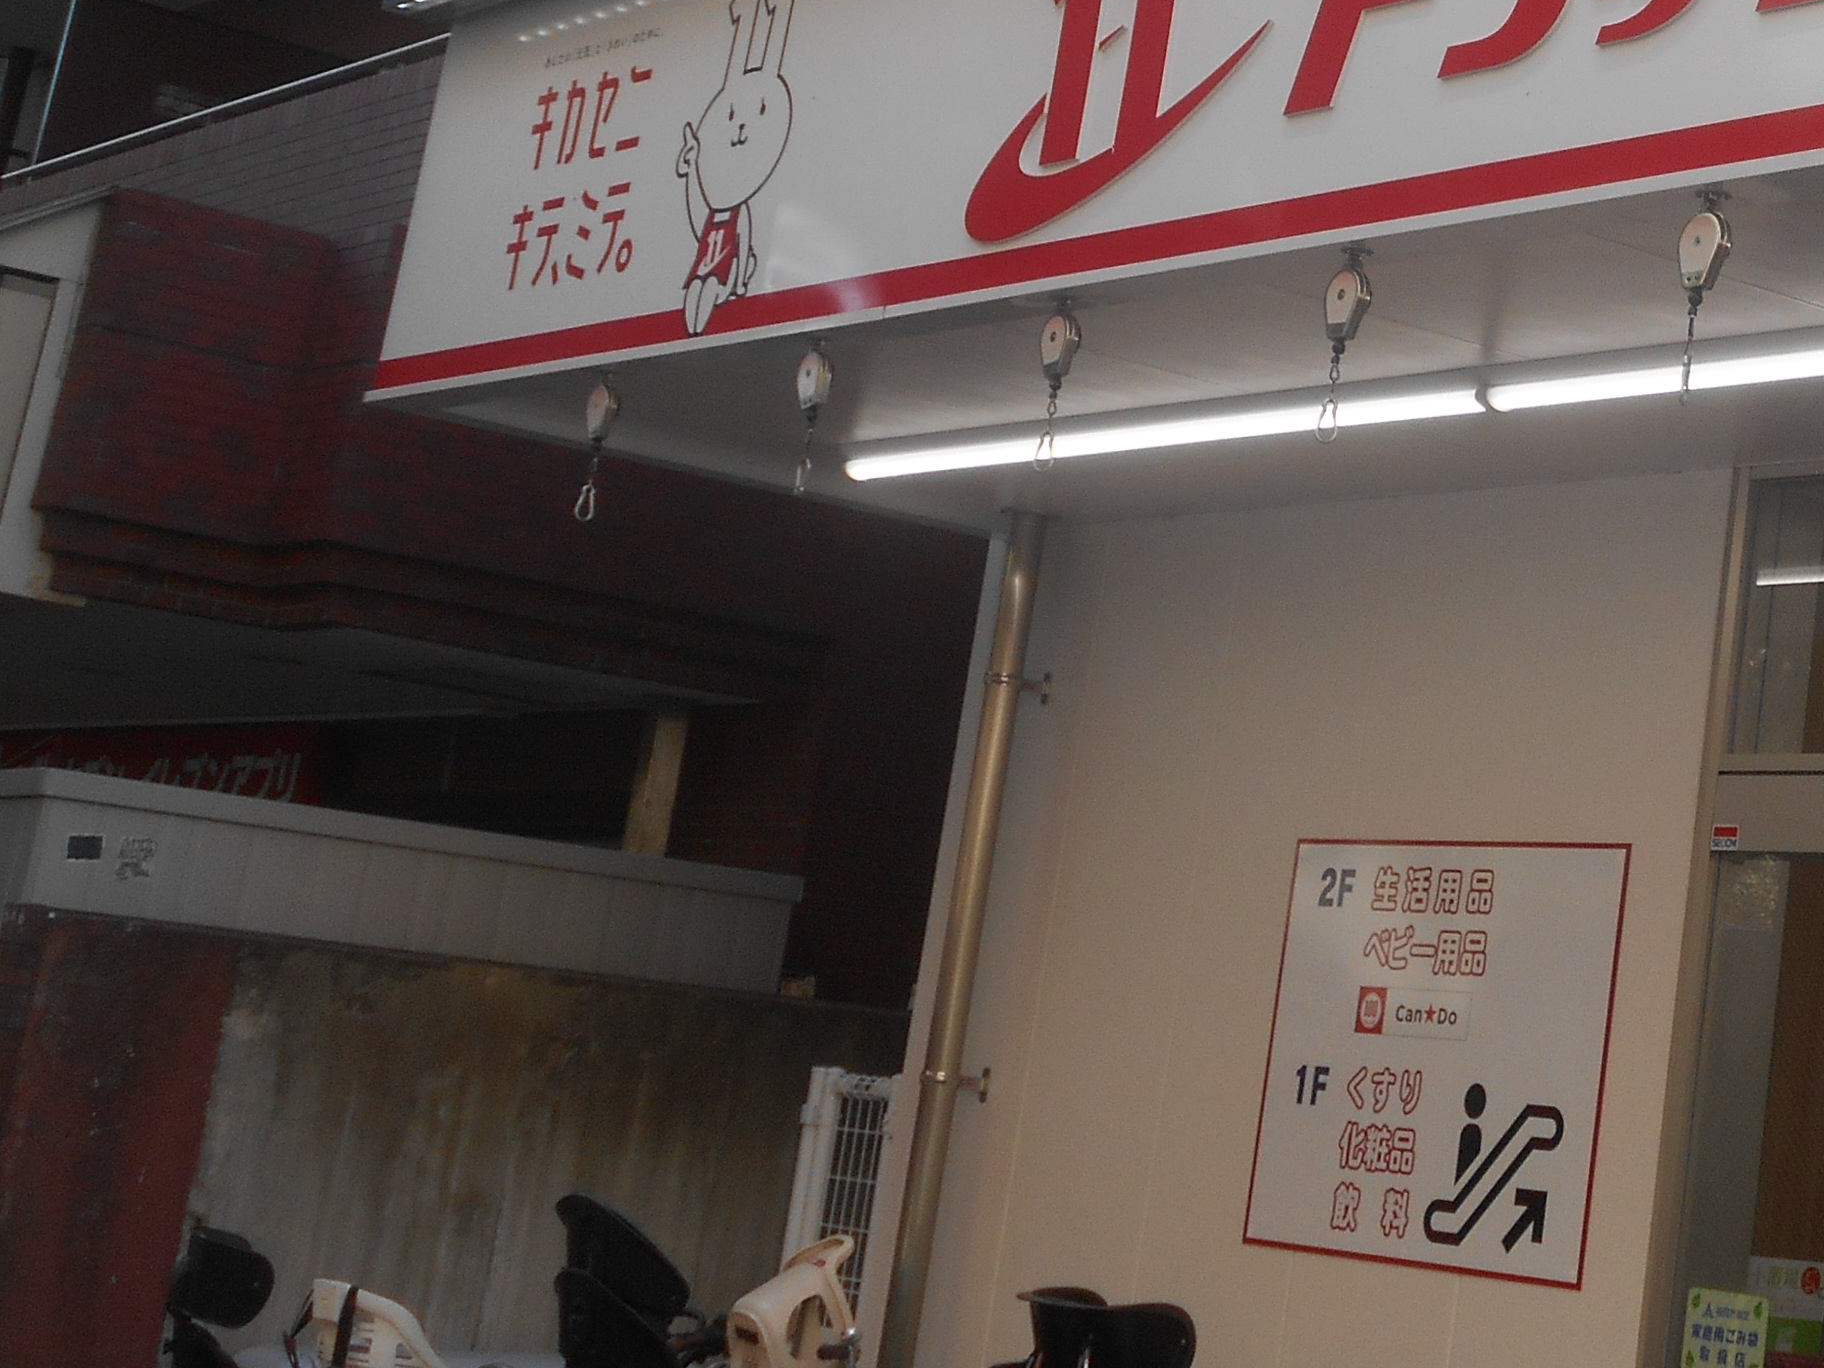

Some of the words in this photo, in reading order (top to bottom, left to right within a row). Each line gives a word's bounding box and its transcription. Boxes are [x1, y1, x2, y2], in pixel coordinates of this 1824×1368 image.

[531, 65, 653, 170] キカセニ
[1317, 867, 1357, 907] 2F
[1371, 865, 1495, 914] 生活用品
[1364, 925, 1488, 976] ベビー用品
[1295, 1064, 1330, 1106] 1F
[1346, 1065, 1423, 1115] くすり
[1338, 1119, 1417, 1175] 化粧品
